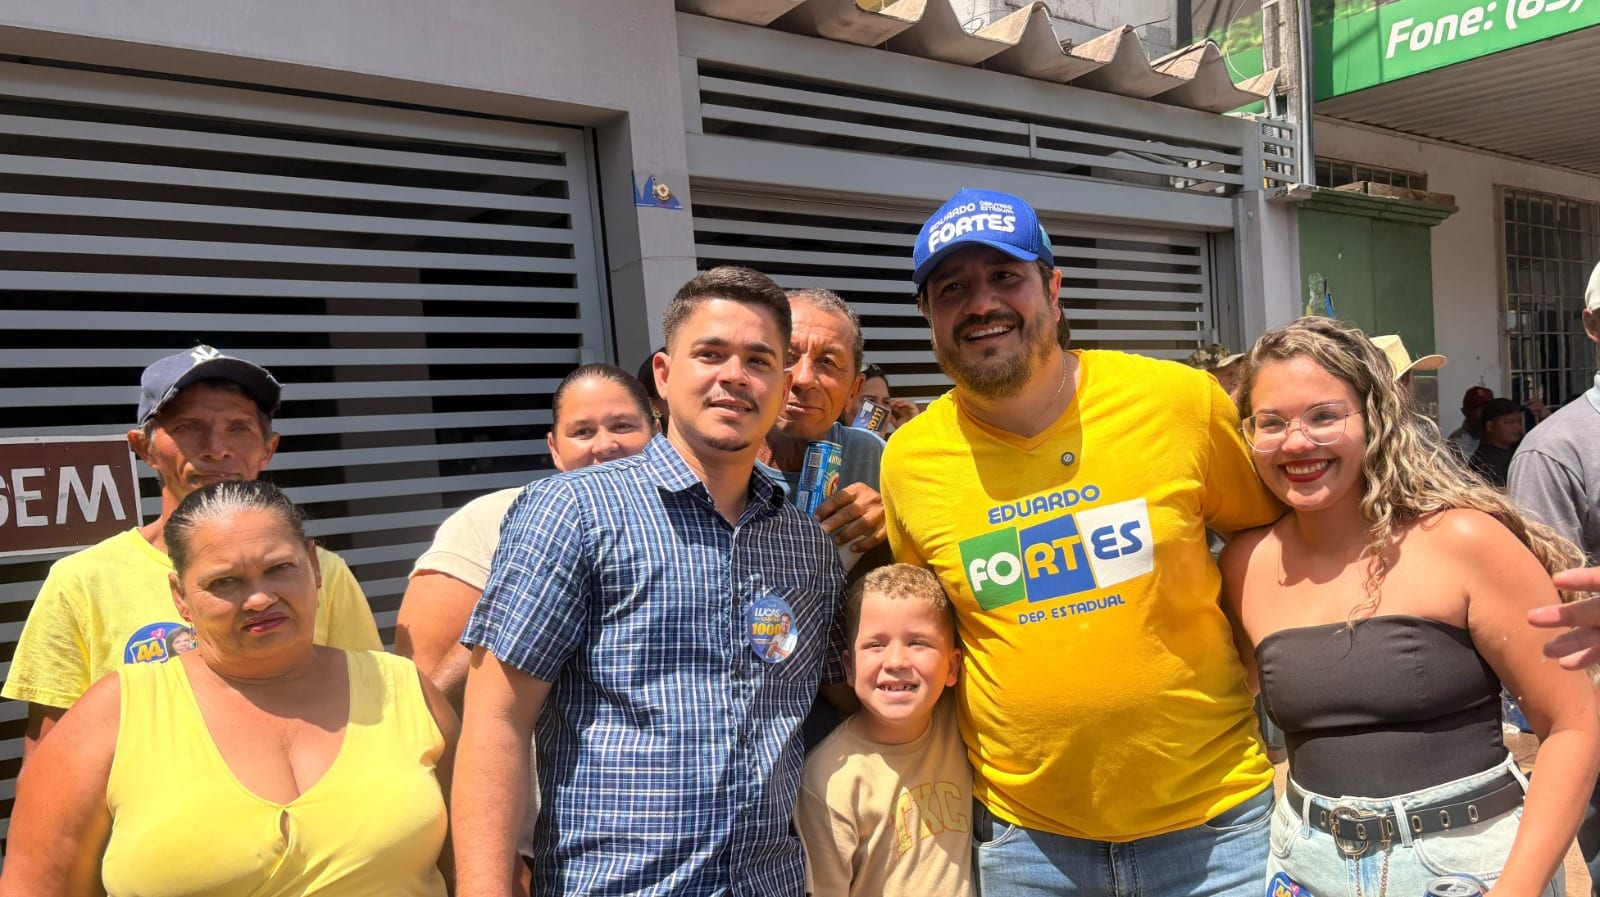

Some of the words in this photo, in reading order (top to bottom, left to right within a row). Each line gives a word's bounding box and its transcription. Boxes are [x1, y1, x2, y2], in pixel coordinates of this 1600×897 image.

[1386, 2, 1497, 59] Fone:
[929, 202, 976, 233] EDUARDO
[928, 213, 1016, 254] FORTES
[987, 484, 1100, 525] EDUARDO
[754, 607, 780, 617] LUCAS
[1018, 611, 1048, 625] DEP.
[1052, 594, 1125, 619] ESTADUAL
[136, 640, 164, 661] 44
